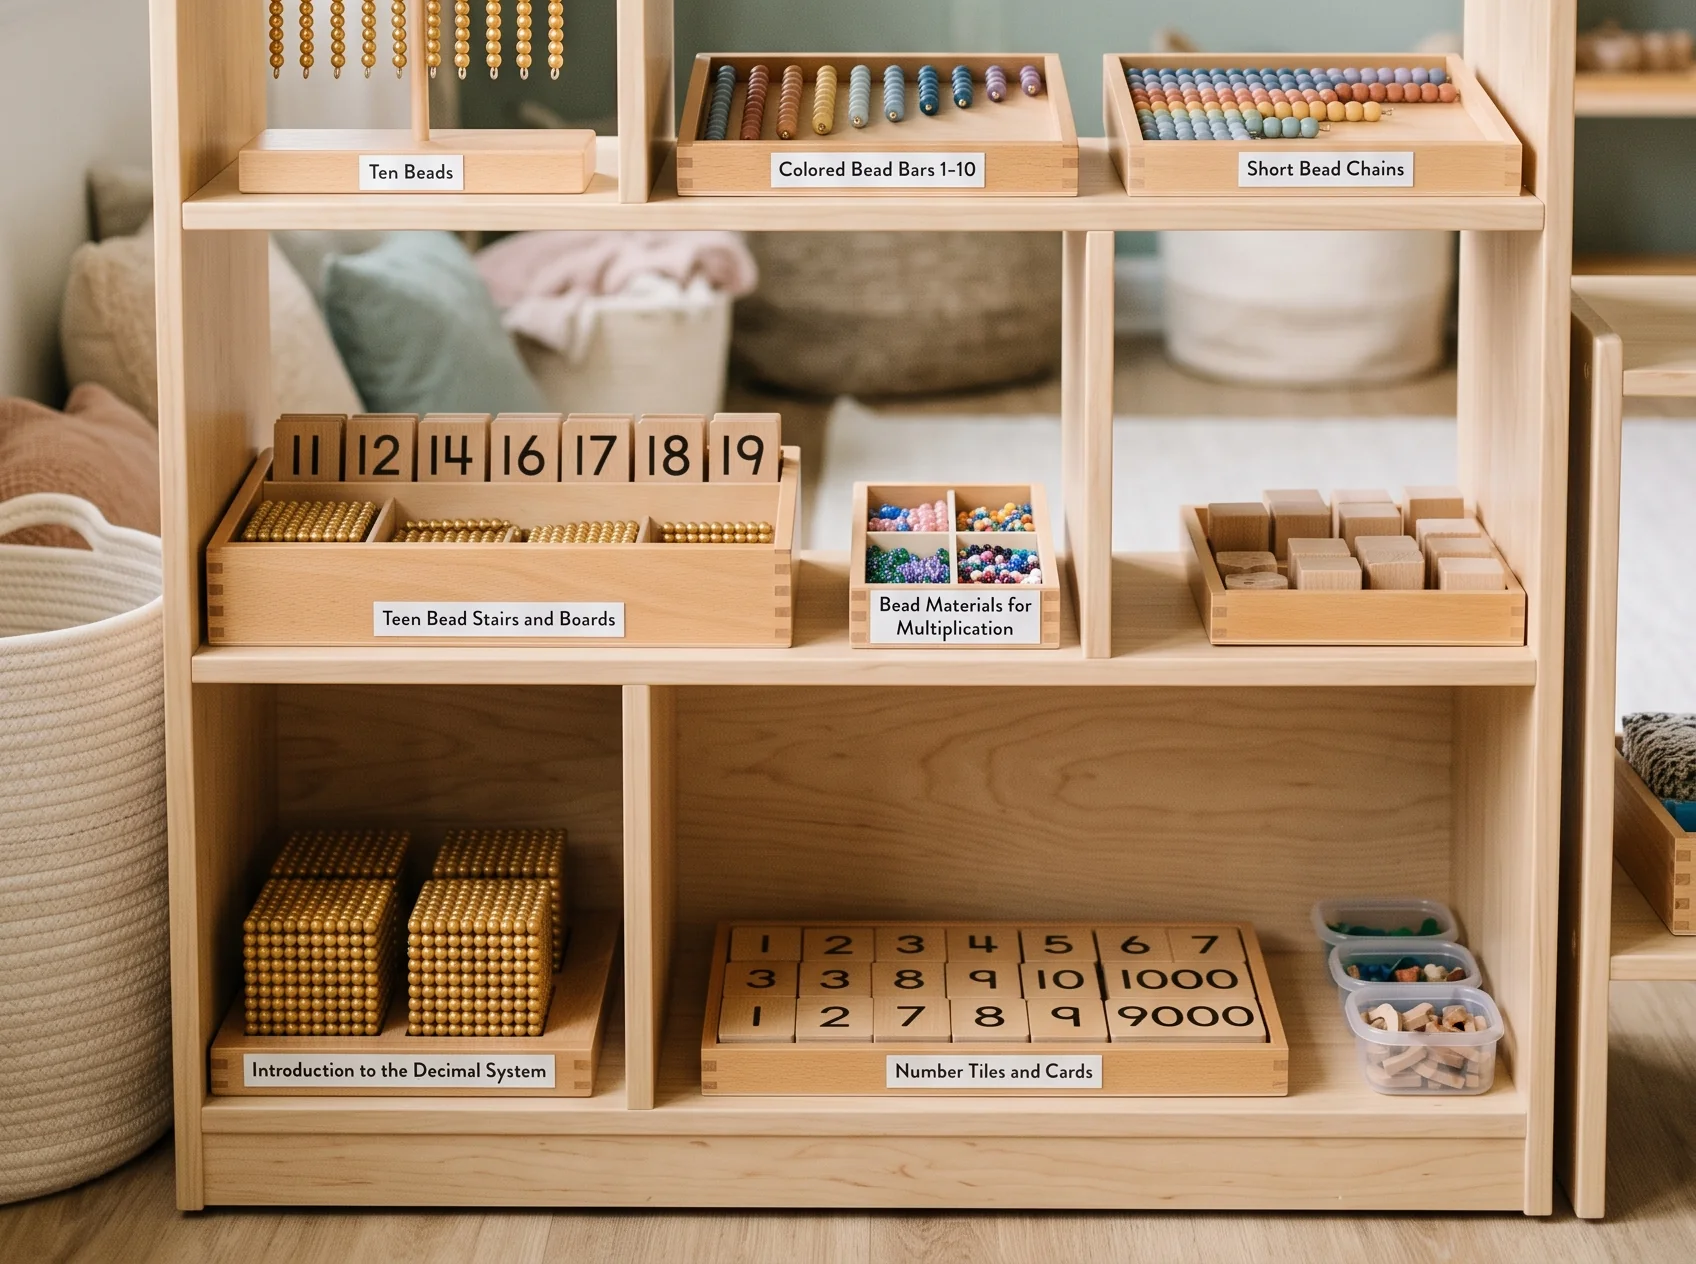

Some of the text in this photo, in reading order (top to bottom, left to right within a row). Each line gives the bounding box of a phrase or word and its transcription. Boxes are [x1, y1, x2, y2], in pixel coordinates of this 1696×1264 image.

[368, 163, 454, 180] Ten Beads
[778, 160, 845, 177] Colored
[851, 160, 893, 177] Bead
[898, 160, 935, 177] Bars
[1247, 159, 1405, 177] Short Bead Chains
[292, 435, 319, 475] 11
[358, 434, 400, 476] 12
[430, 434, 473, 476] 14
[503, 434, 545, 477] 16
[576, 434, 617, 476] 17
[648, 434, 690, 477] 18
[723, 434, 764, 476] 19
[880, 596, 1032, 613] Bead Materials for
[382, 610, 616, 627] Teen Bead Stairs and Boards
[896, 619, 1014, 642] Multiplication
[760, 934, 769, 953] 1
[823, 935, 853, 955] 2
[896, 934, 925, 954] 3
[967, 935, 998, 954] 4
[1044, 935, 1074, 955] 5
[1120, 935, 1151, 955] 6
[1191, 935, 1219, 954] 7
[746, 969, 777, 989] 3
[819, 969, 850, 989] 3
[893, 969, 925, 990] 8
[968, 969, 997, 989] 9
[1037, 969, 1085, 990] 10
[1121, 969, 1240, 990] 1000
[752, 1005, 762, 1027] 1
[819, 1006, 850, 1028] 2
[896, 1005, 926, 1027] 7
[974, 1006, 1005, 1028] 8
[1051, 1006, 1081, 1027] 9
[1116, 1005, 1255, 1027] 9000
[252, 1061, 546, 1083] Introduction to the Decimal System
[895, 1062, 1093, 1079] Number Tiles and Cards
